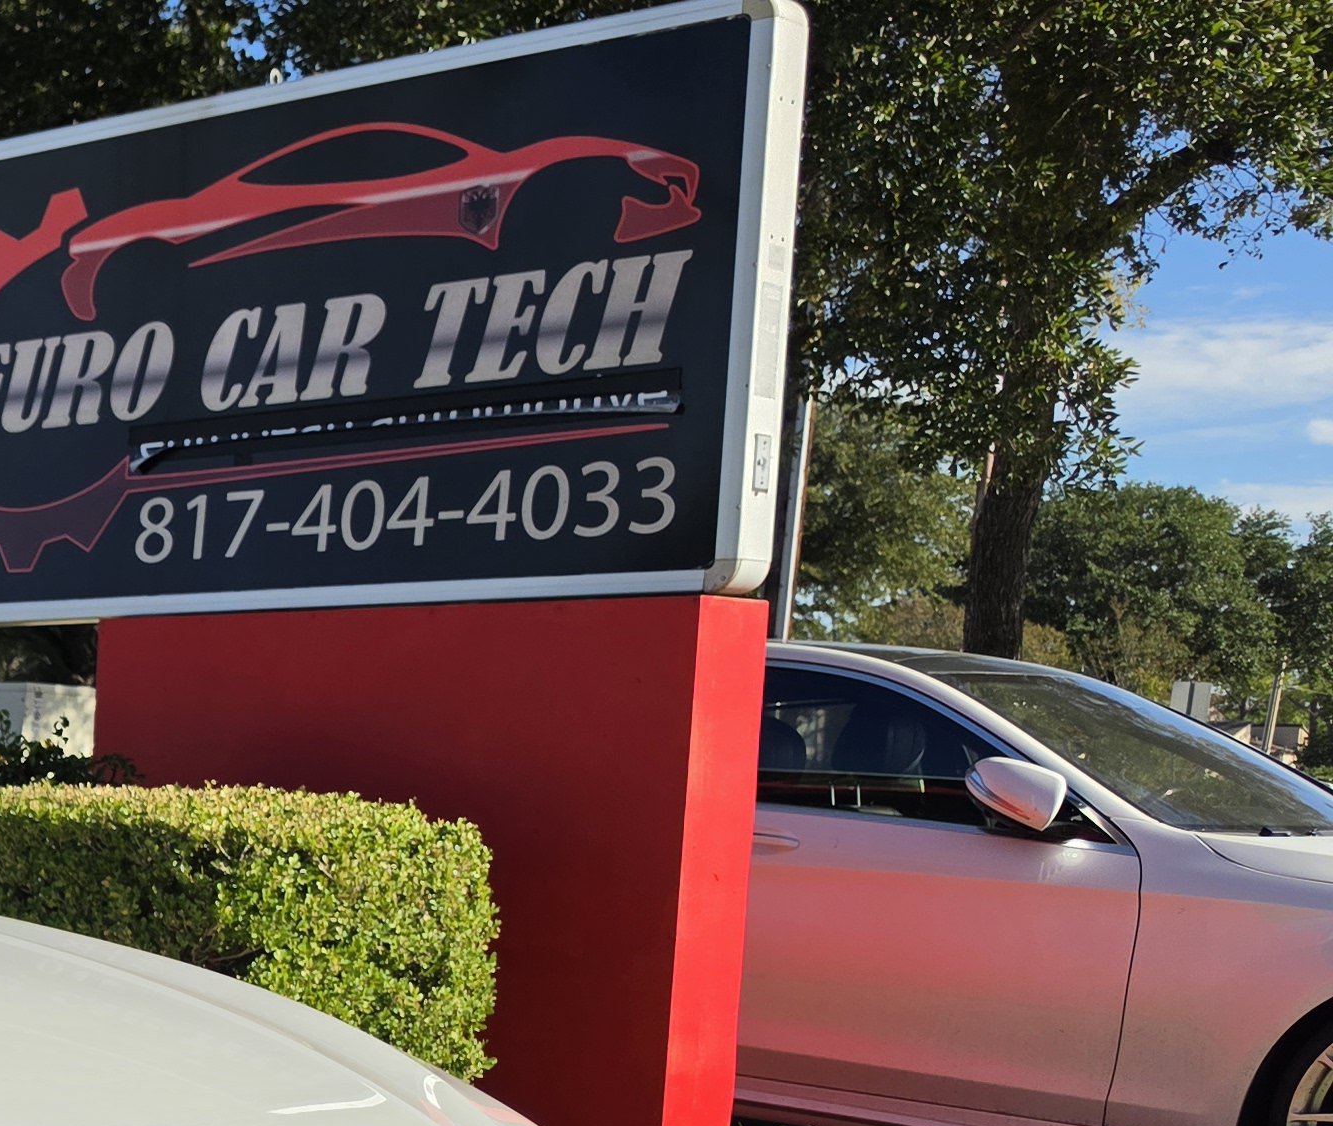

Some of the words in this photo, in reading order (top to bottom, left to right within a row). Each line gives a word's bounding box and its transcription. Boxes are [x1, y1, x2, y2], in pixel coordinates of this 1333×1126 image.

[200, 292, 386, 413] CAR
[413, 249, 694, 391] TECH
[134, 456, 677, 565] 817-404-4033
